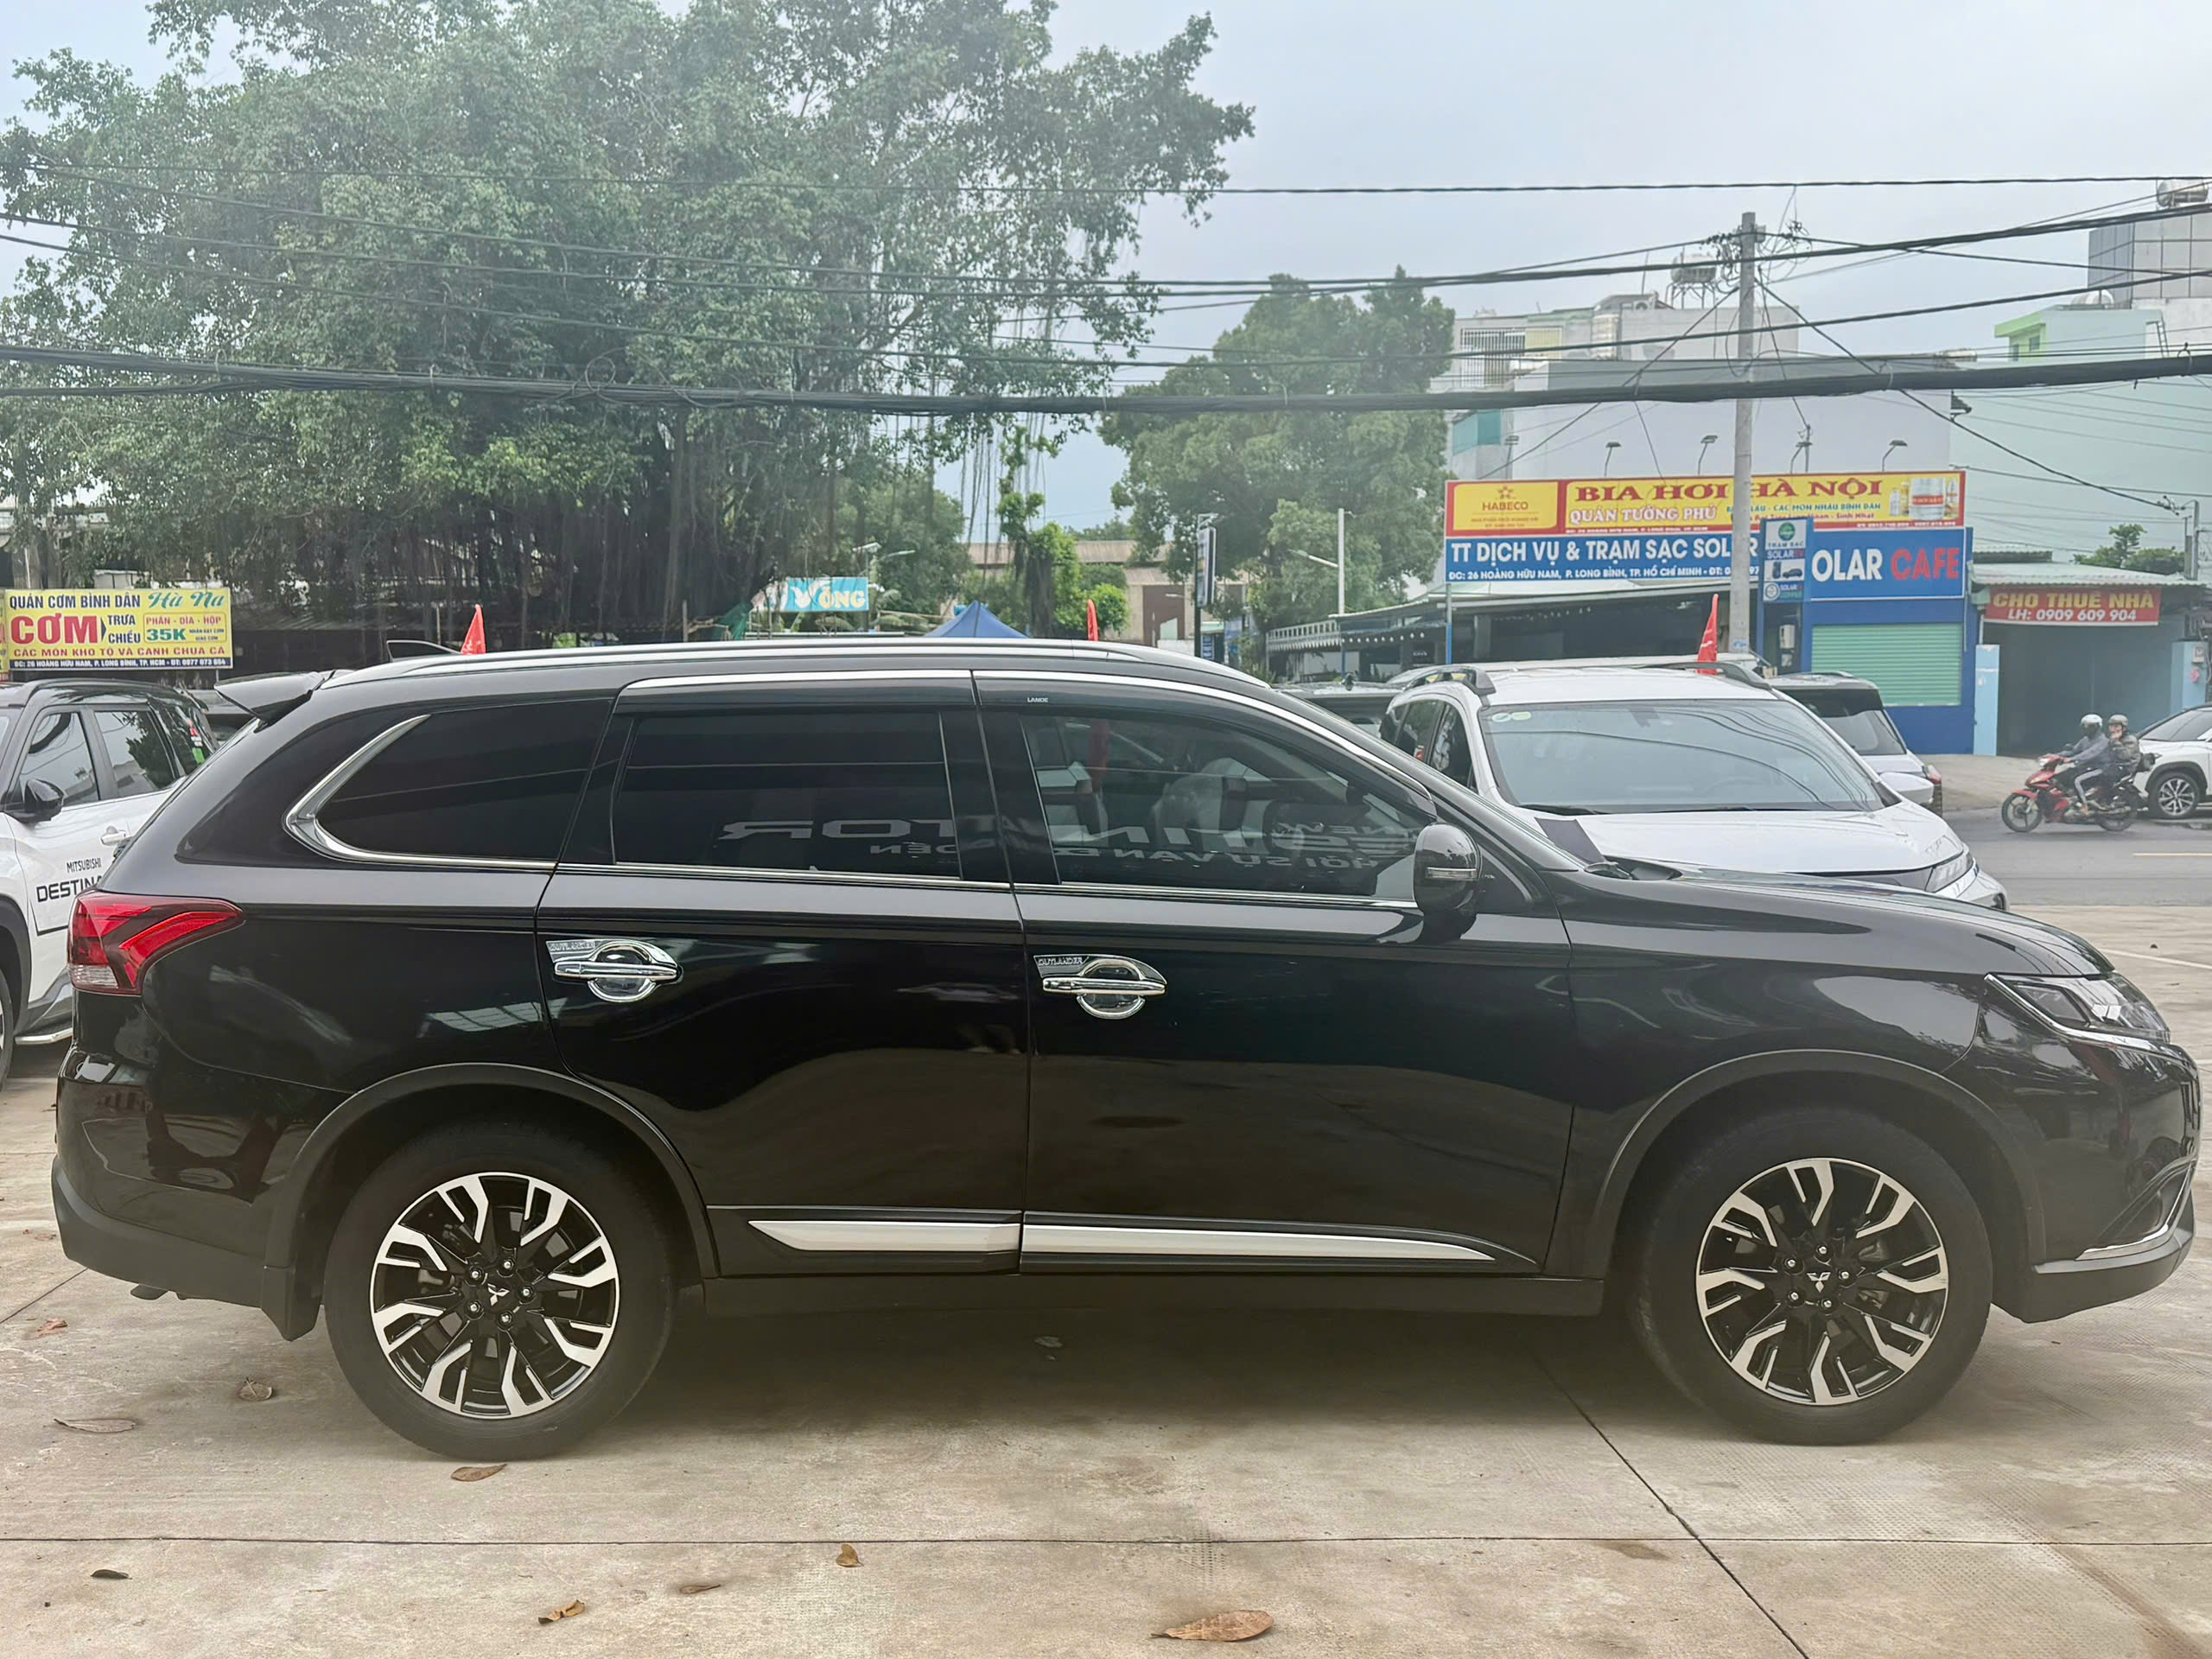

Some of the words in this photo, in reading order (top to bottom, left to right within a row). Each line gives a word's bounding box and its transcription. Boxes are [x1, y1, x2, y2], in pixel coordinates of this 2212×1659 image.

[1575, 486, 1643, 502] BIA
[1653, 483, 1728, 500] HƠI
[1807, 477, 1883, 499] NỘI
[1482, 501, 1529, 511] HABECO
[1570, 506, 1618, 525] QUÁN
[1477, 541, 1527, 567] DỊCH
[1532, 540, 1560, 566] VỤ
[1566, 541, 1580, 561] &
[1586, 539, 1641, 564] TRẠM
[1645, 537, 1688, 563] SẠC
[1693, 537, 1758, 560] SOLR
[1468, 571, 1479, 580] 26
[1480, 568, 1515, 580] HOÀNG
[1538, 569, 1562, 580] NAM,
[1575, 569, 1601, 578] LONG
[1603, 566, 1628, 578] BÌNH,
[1660, 565, 1676, 576] CHÍ
[1677, 567, 1702, 576] MINH
[1811, 549, 1883, 582] OLAR
[1891, 548, 1960, 581] CAFE
[10, 593, 43, 610] QUÁN
[48, 594, 76, 608] CƠM
[80, 593, 111, 608] BÌNH
[115, 592, 141, 608] DÂN
[1993, 593, 2038, 609] CHO
[2047, 589, 2101, 609] THUÊ
[2108, 590, 2154, 609] NHÀ
[108, 614, 136, 626] TRƯA
[2007, 608, 2031, 620] LH:
[2036, 609, 2074, 621] 0909
[2077, 609, 2106, 621] 609
[2109, 609, 2137, 621] 904
[10, 613, 99, 645] CƠM
[146, 628, 186, 641] 35K
[73, 648, 95, 657] KHO
[138, 647, 169, 656] CANH
[173, 646, 205, 655] CHUA
[66, 857, 102, 874] MITSUBISHI
[35, 875, 103, 903] DESTIN
[1038, 957, 1084, 966] OUTLANDER
